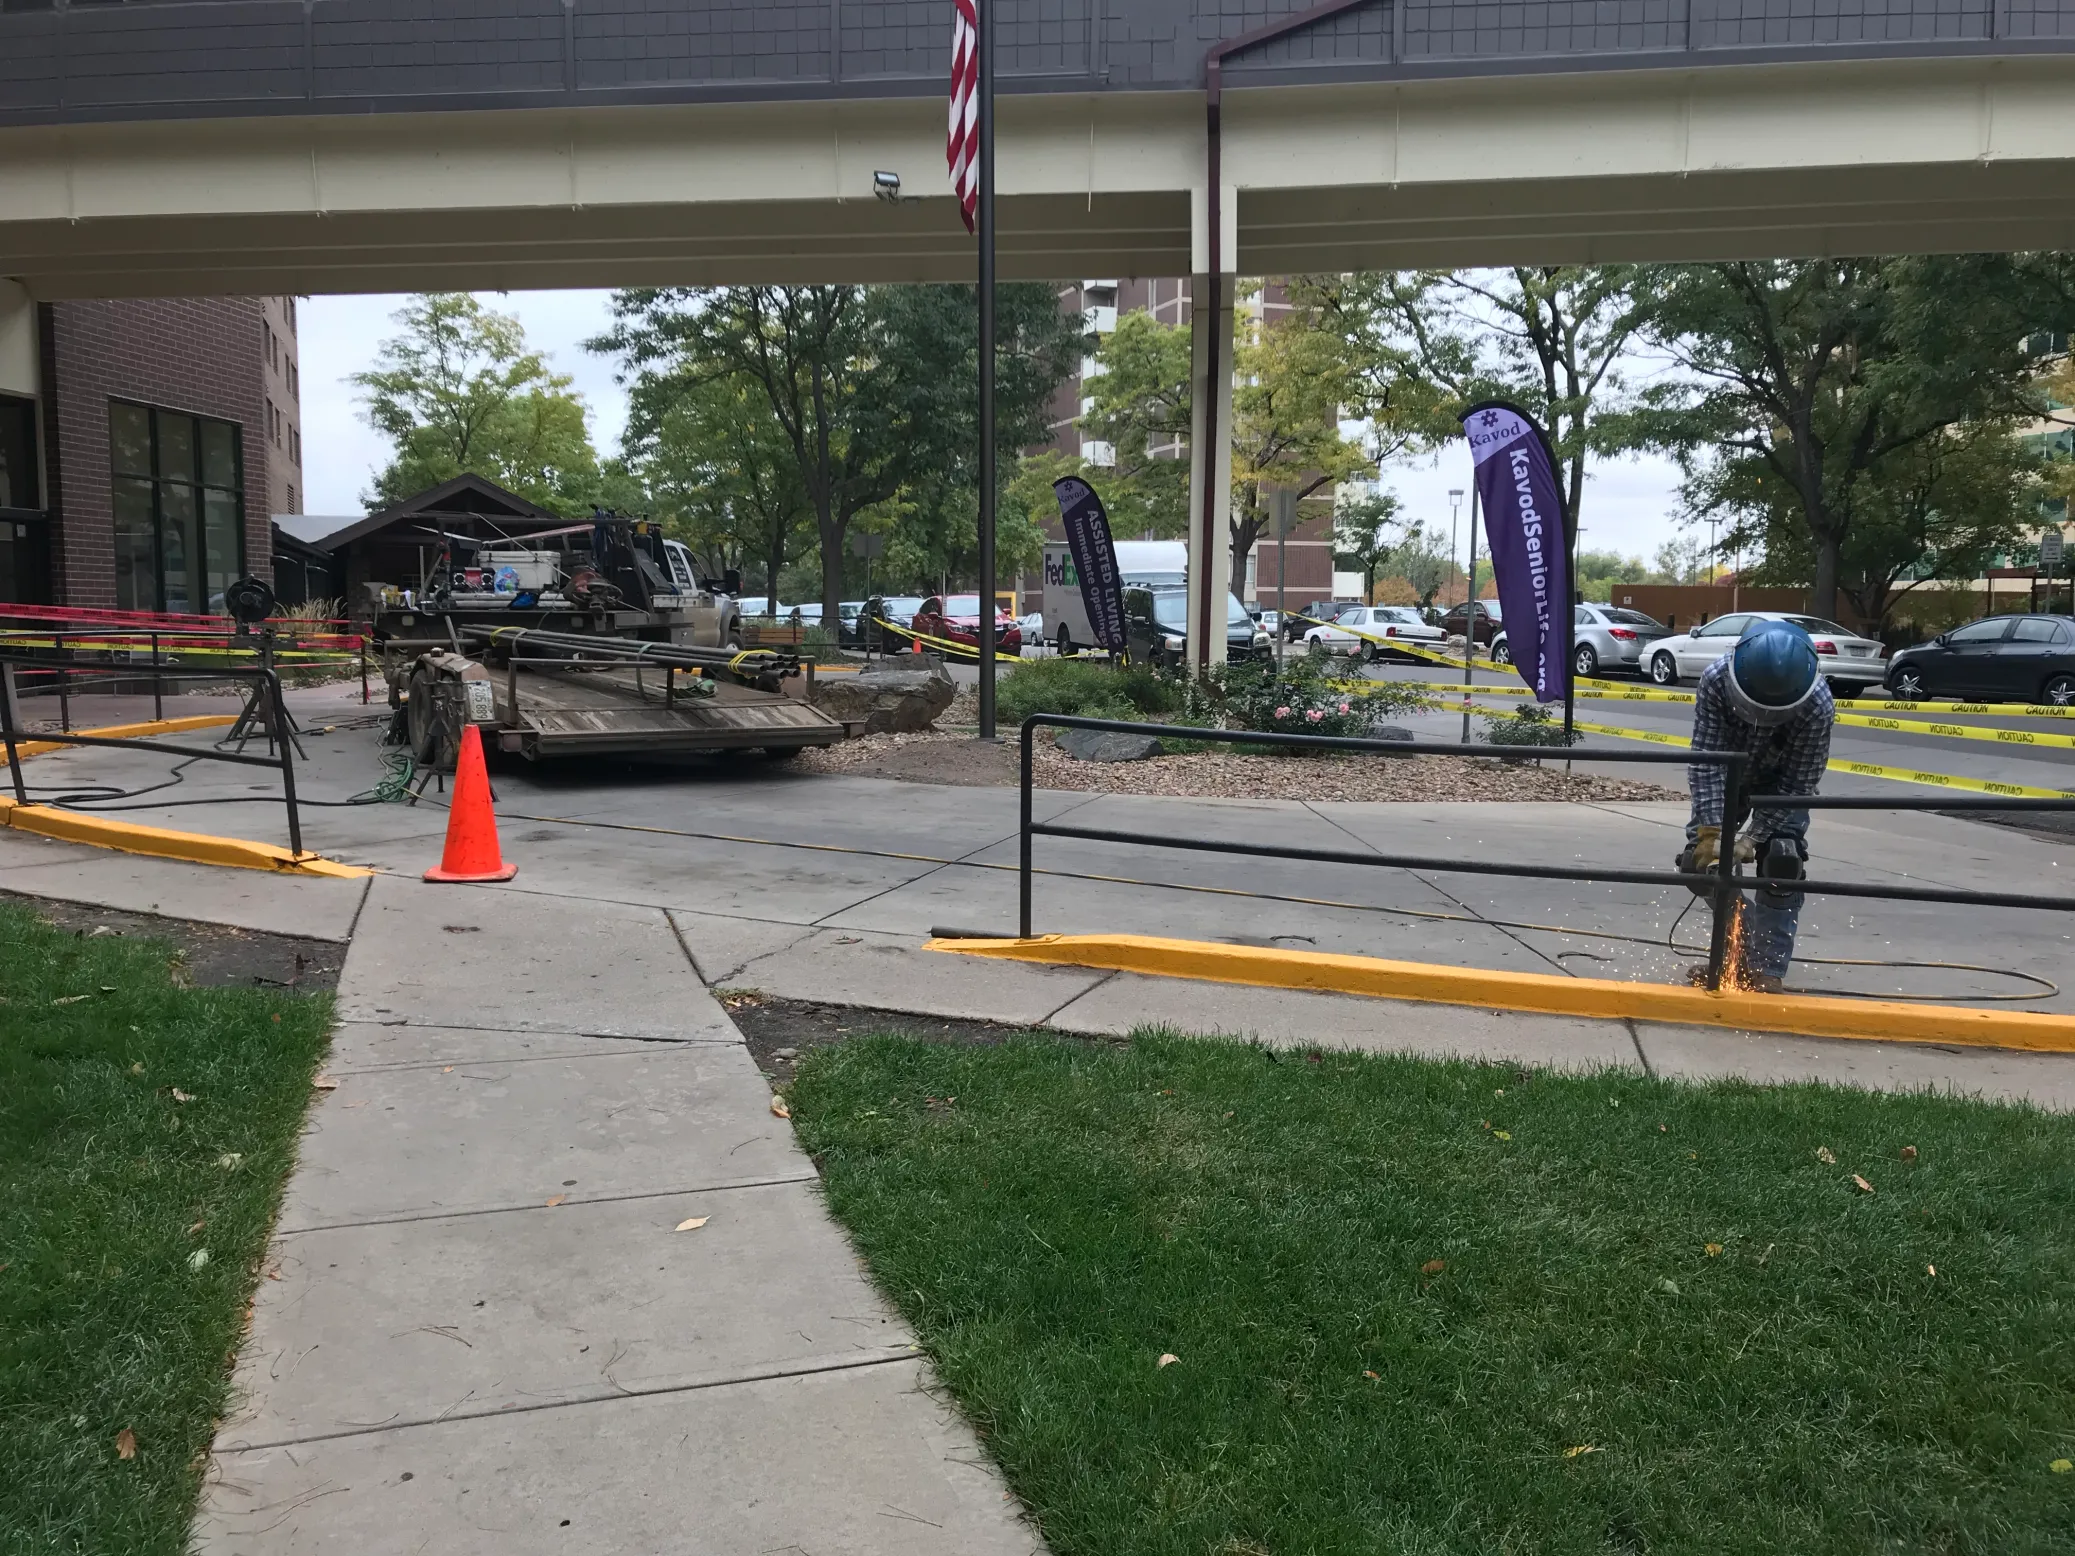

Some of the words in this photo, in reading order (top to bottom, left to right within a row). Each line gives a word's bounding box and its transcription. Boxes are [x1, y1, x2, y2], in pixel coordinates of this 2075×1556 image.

[1469, 421, 1521, 449] Kavod
[1058, 488, 1085, 503] Kavod
[1075, 517, 1095, 584] Immediate
[1090, 587, 1109, 646] Openings!
[1087, 510, 1112, 584] ASSISTED
[1105, 588, 1123, 644] LIVING
[1506, 687, 1526, 695] CAUTION
[1622, 692, 1647, 700] CAUTION
[1667, 694, 1693, 702] CAUTION
[1884, 701, 1919, 711] CAUTION
[1951, 703, 1989, 714] CAUTION
[2025, 706, 2067, 716] CAUTION
